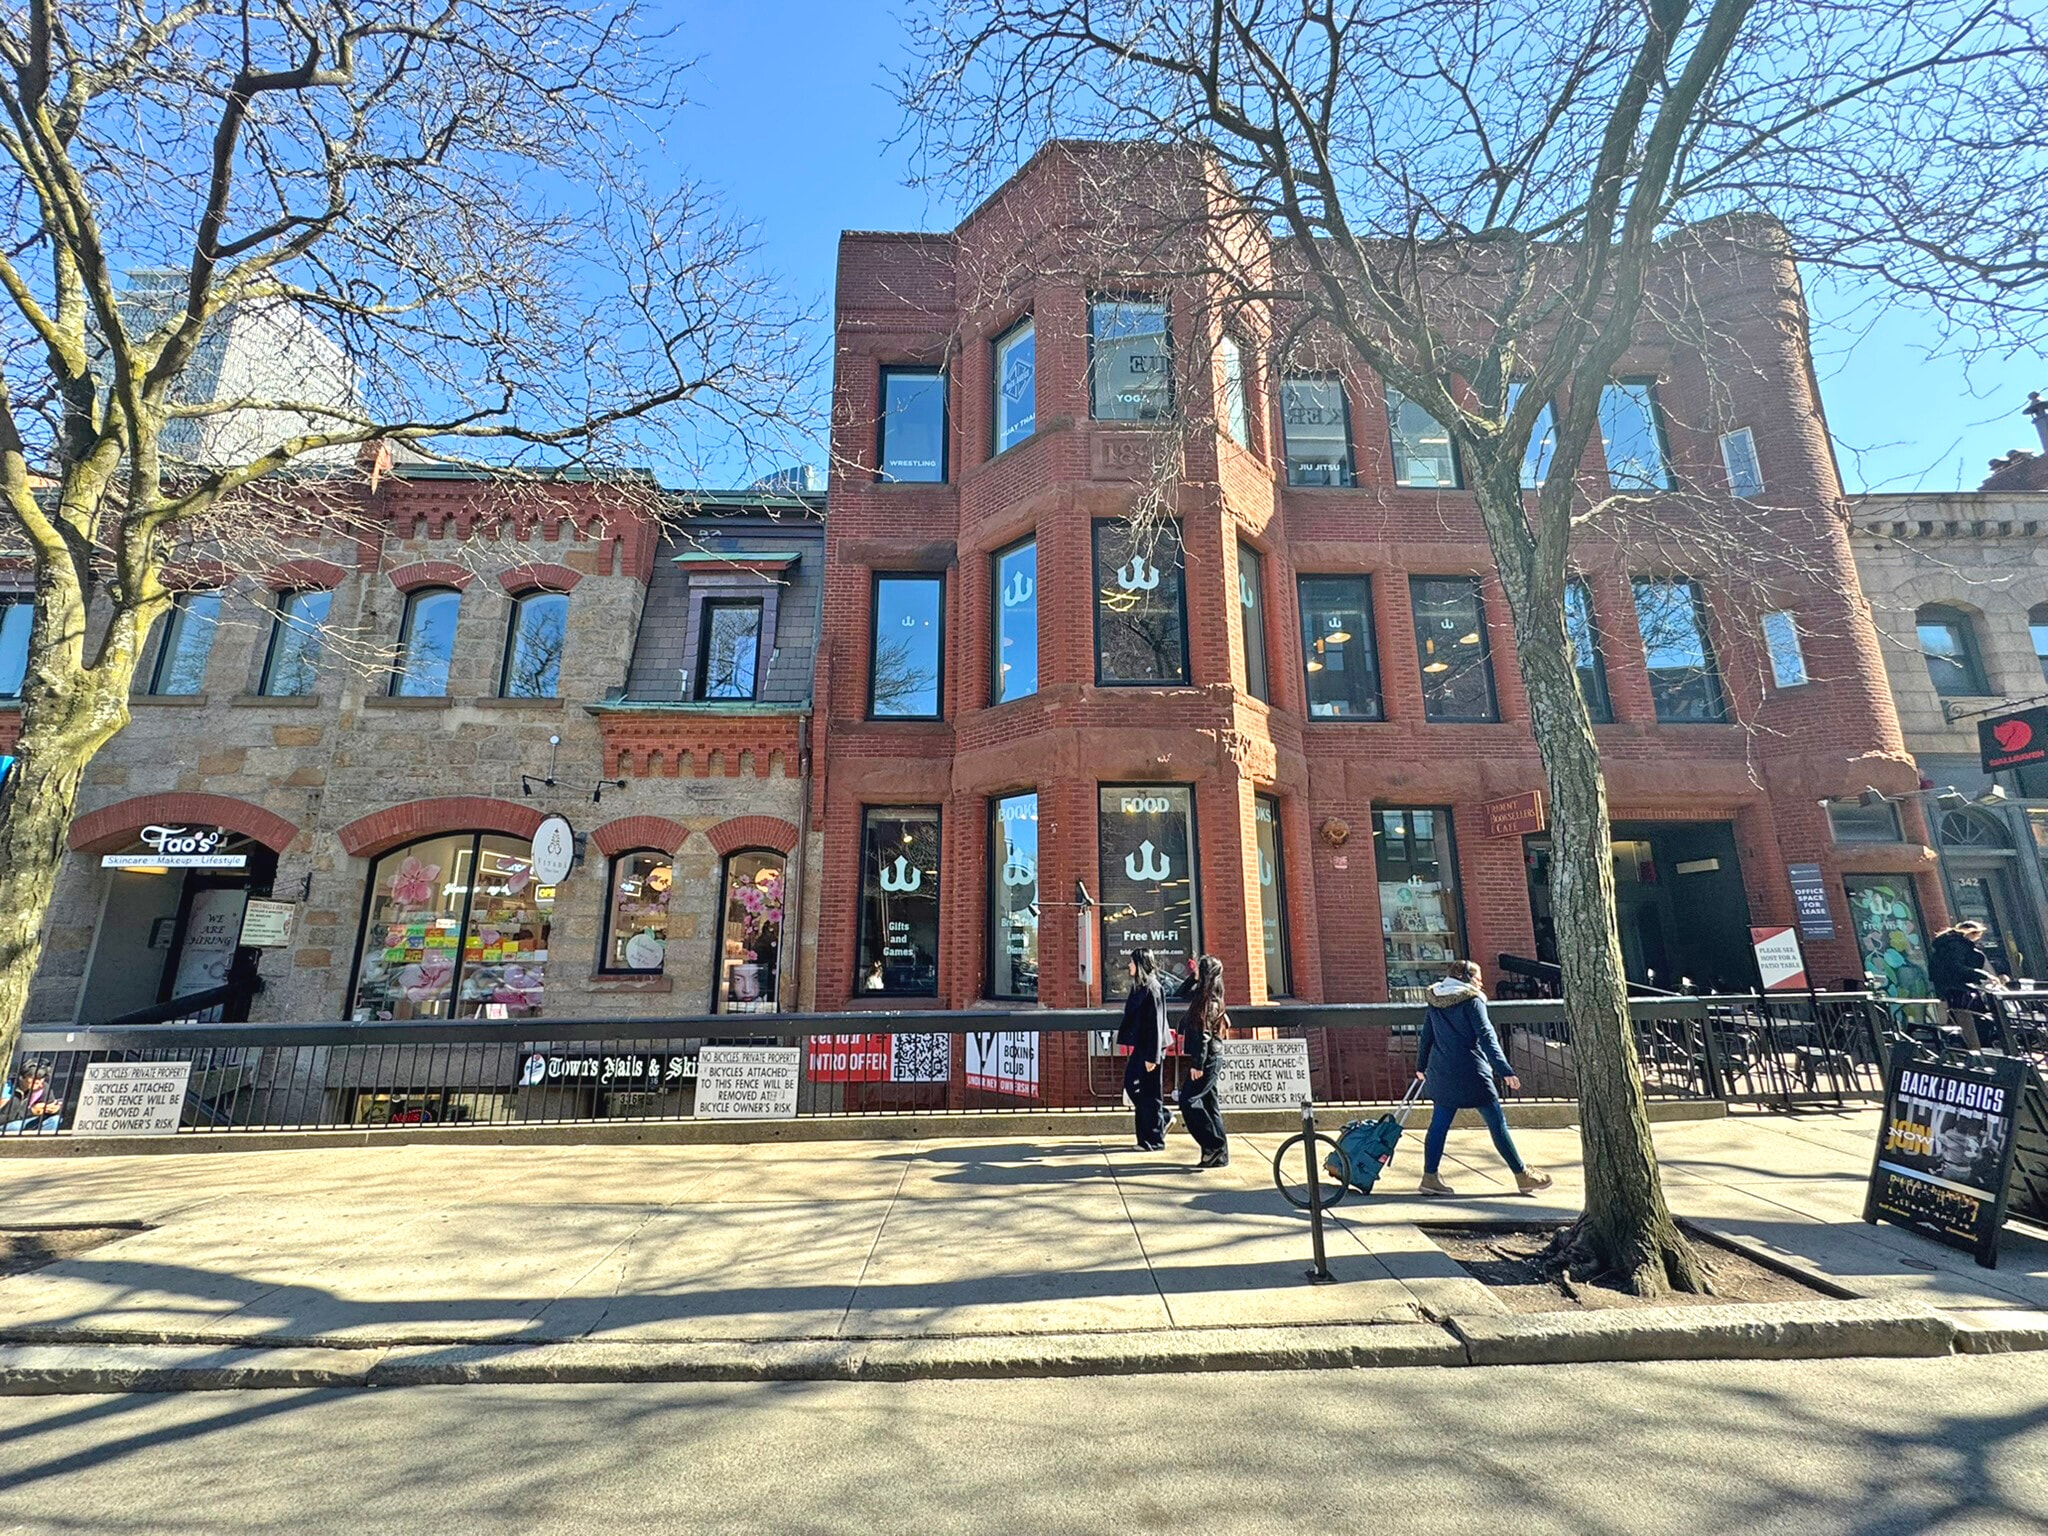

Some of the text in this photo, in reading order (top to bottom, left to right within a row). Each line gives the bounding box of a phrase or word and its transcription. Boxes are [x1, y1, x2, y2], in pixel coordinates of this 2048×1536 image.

[1298, 463, 1341, 471] JIU JITSU
[1121, 797, 1170, 813] FOOD
[108, 856, 241, 866] Skincare Makeup Lifestyle
[1959, 878, 1980, 887] 342
[538, 887, 556, 898] OPE
[208, 914, 224, 923] WE
[201, 926, 225, 934] ARE
[888, 921, 910, 931] Gifts
[890, 934, 907, 943] and
[1123, 930, 1179, 941] Free Wi-Fi
[883, 947, 914, 956] Games
[702, 1052, 711, 1062] NO
[1004, 1045, 1034, 1060] BOXING
[809, 1053, 887, 1070] INTRO OFFER
[1222, 1058, 1297, 1070] BICYCLES ATTACHED
[89, 1068, 99, 1078] NO
[548, 1057, 599, 1076] Town's
[649, 1058, 661, 1077] &
[665, 1056, 700, 1081] Ski
[709, 1067, 788, 1077] BICYCLES ATTACHED
[1004, 1062, 1024, 1075] CLUB
[1230, 1071, 1246, 1080] THIS
[1249, 1070, 1272, 1080] FENCE
[1275, 1070, 1293, 1080] WILL
[1296, 1070, 1305, 1079] BE
[93, 1083, 175, 1094] BICYCLES ATTACHED
[701, 1079, 794, 1089] TO THIS FENCE WILL BE
[1235, 1081, 1286, 1092] REMOVED AT
[1900, 1070, 1939, 1100] BACK
[83, 1094, 180, 1106] TO THIS FENCE WILL BE
[718, 1090, 757, 1101] REMOVED
[1219, 1093, 1306, 1104] BICYCLE OWNER'S RISK
[1945, 1079, 2005, 1113] BASICS
[98, 1107, 155, 1118] REMOVED AT
[700, 1102, 791, 1113] BICYCLE OWNER'S RISK
[78, 1118, 174, 1131] BICYCLE OWNER'S RISK
[1887, 1126, 1935, 1145] NOW
